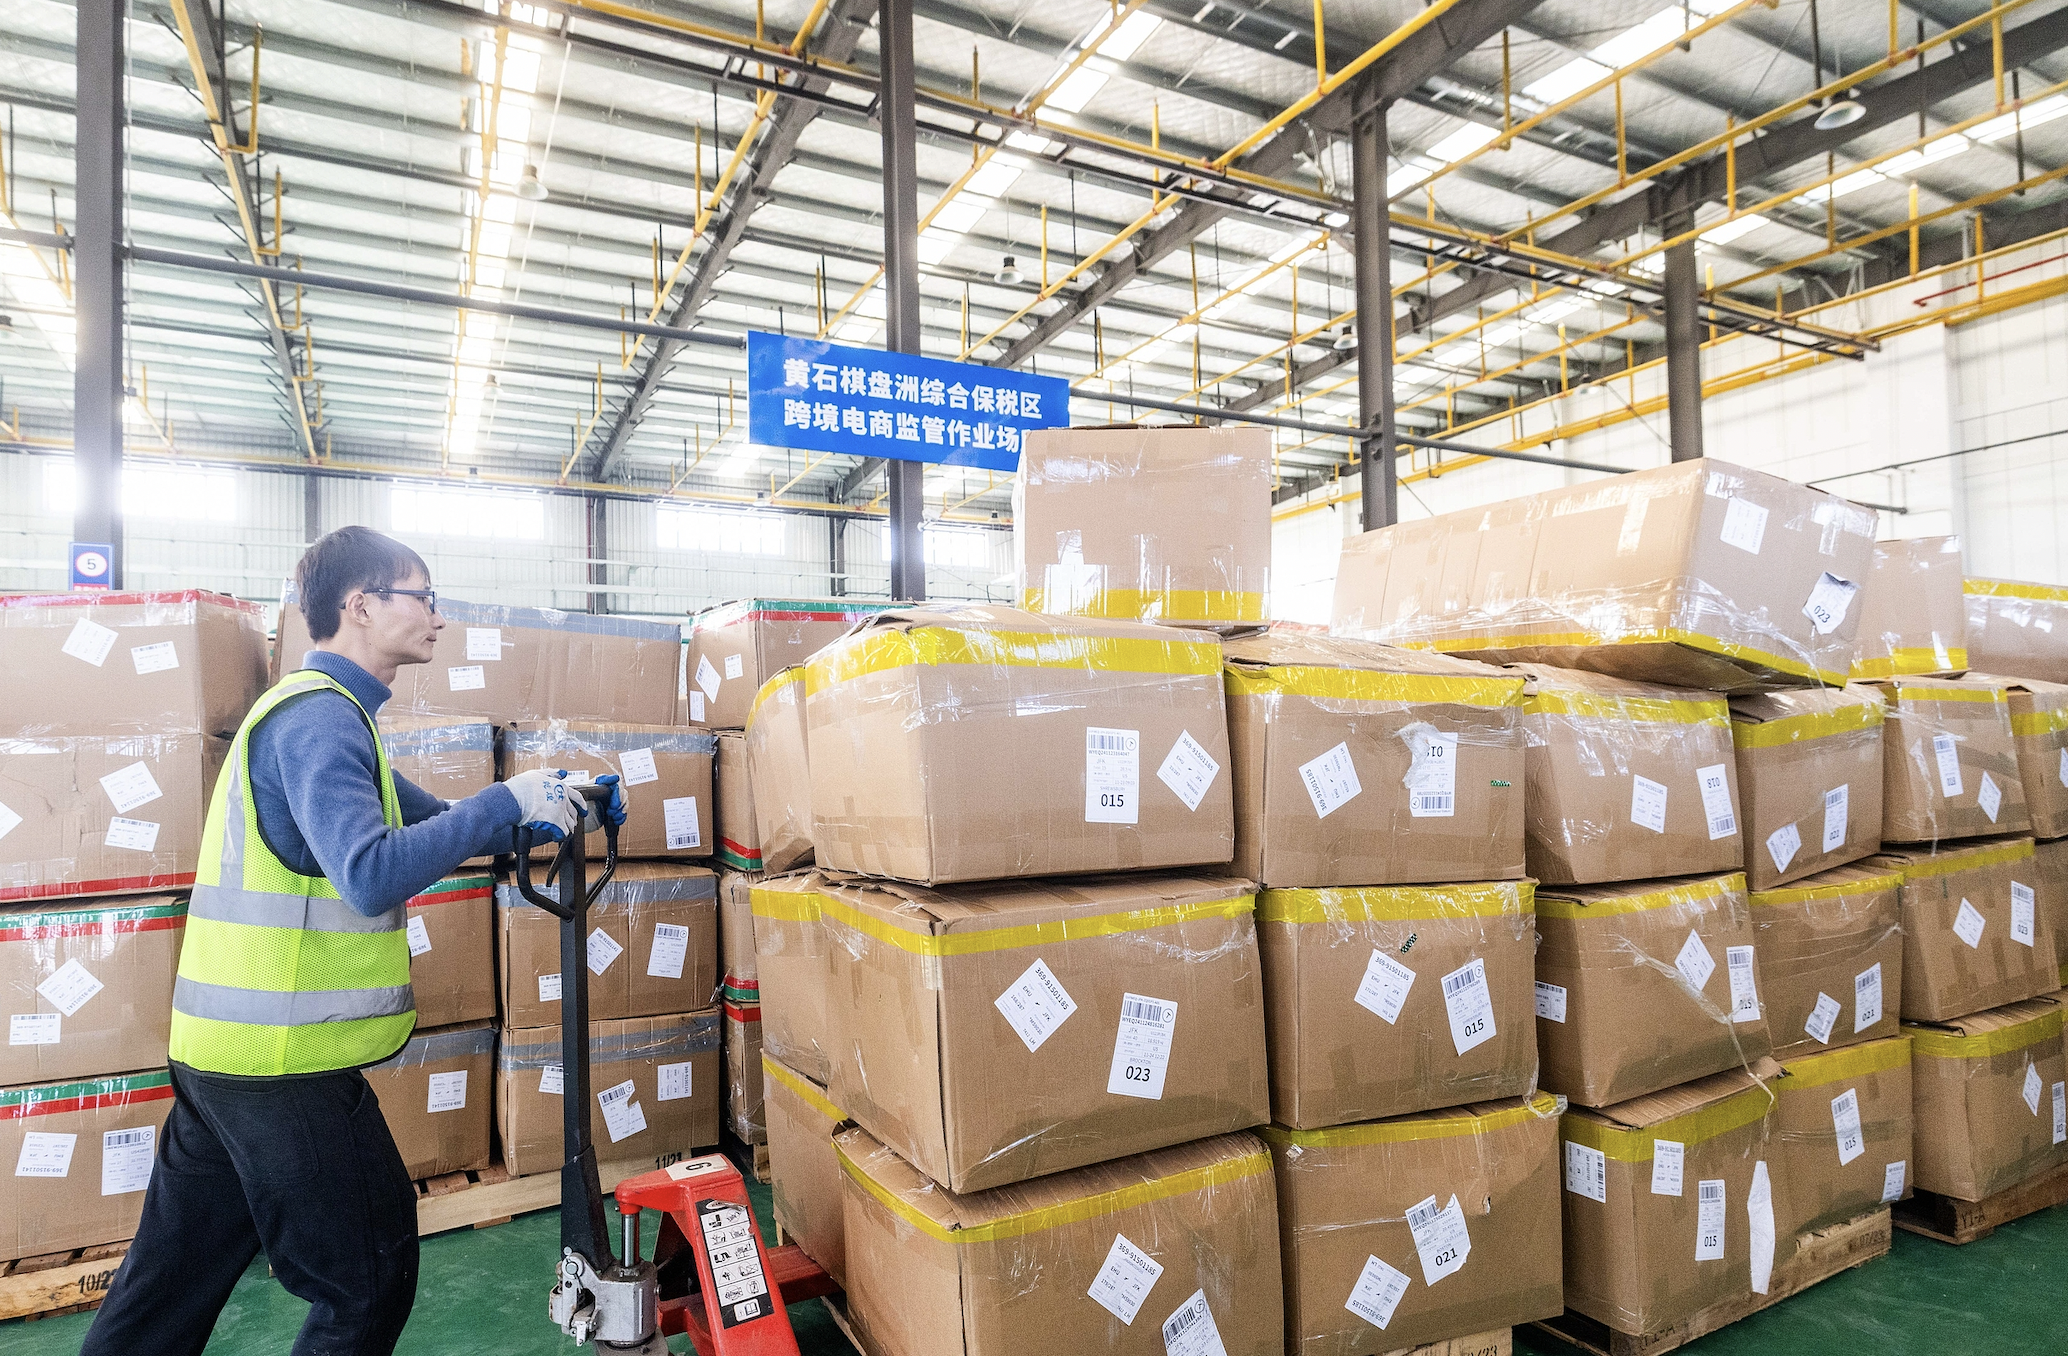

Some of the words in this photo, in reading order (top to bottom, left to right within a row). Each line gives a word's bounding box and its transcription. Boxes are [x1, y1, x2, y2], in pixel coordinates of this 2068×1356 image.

[783, 358, 1042, 419] 黄石棋盘洲综合保税区
[784, 399, 1020, 453] 跨境电商监管作业场
[87, 558, 96, 569] 5
[1813, 604, 1831, 624] 023
[1182, 736, 1214, 772] 369-91501185
[1705, 776, 1721, 788] 018
[1100, 793, 1124, 807] 015
[1022, 985, 1032, 997] EHU
[1034, 966, 1069, 1010] 369-91501185
[1042, 1011, 1051, 1021] JFK
[1862, 1009, 1874, 1021] 021
[1462, 1017, 1485, 1038] 015
[1124, 1065, 1151, 1083] 023
[1843, 1136, 1856, 1150] 015
[21, 1165, 63, 1173] 369-91501141
[1704, 1235, 1716, 1246] 015
[1116, 1241, 1156, 1276] 369-91501185
[1433, 1247, 1458, 1267] 021
[1351, 1298, 1385, 1323] 369-91501185
